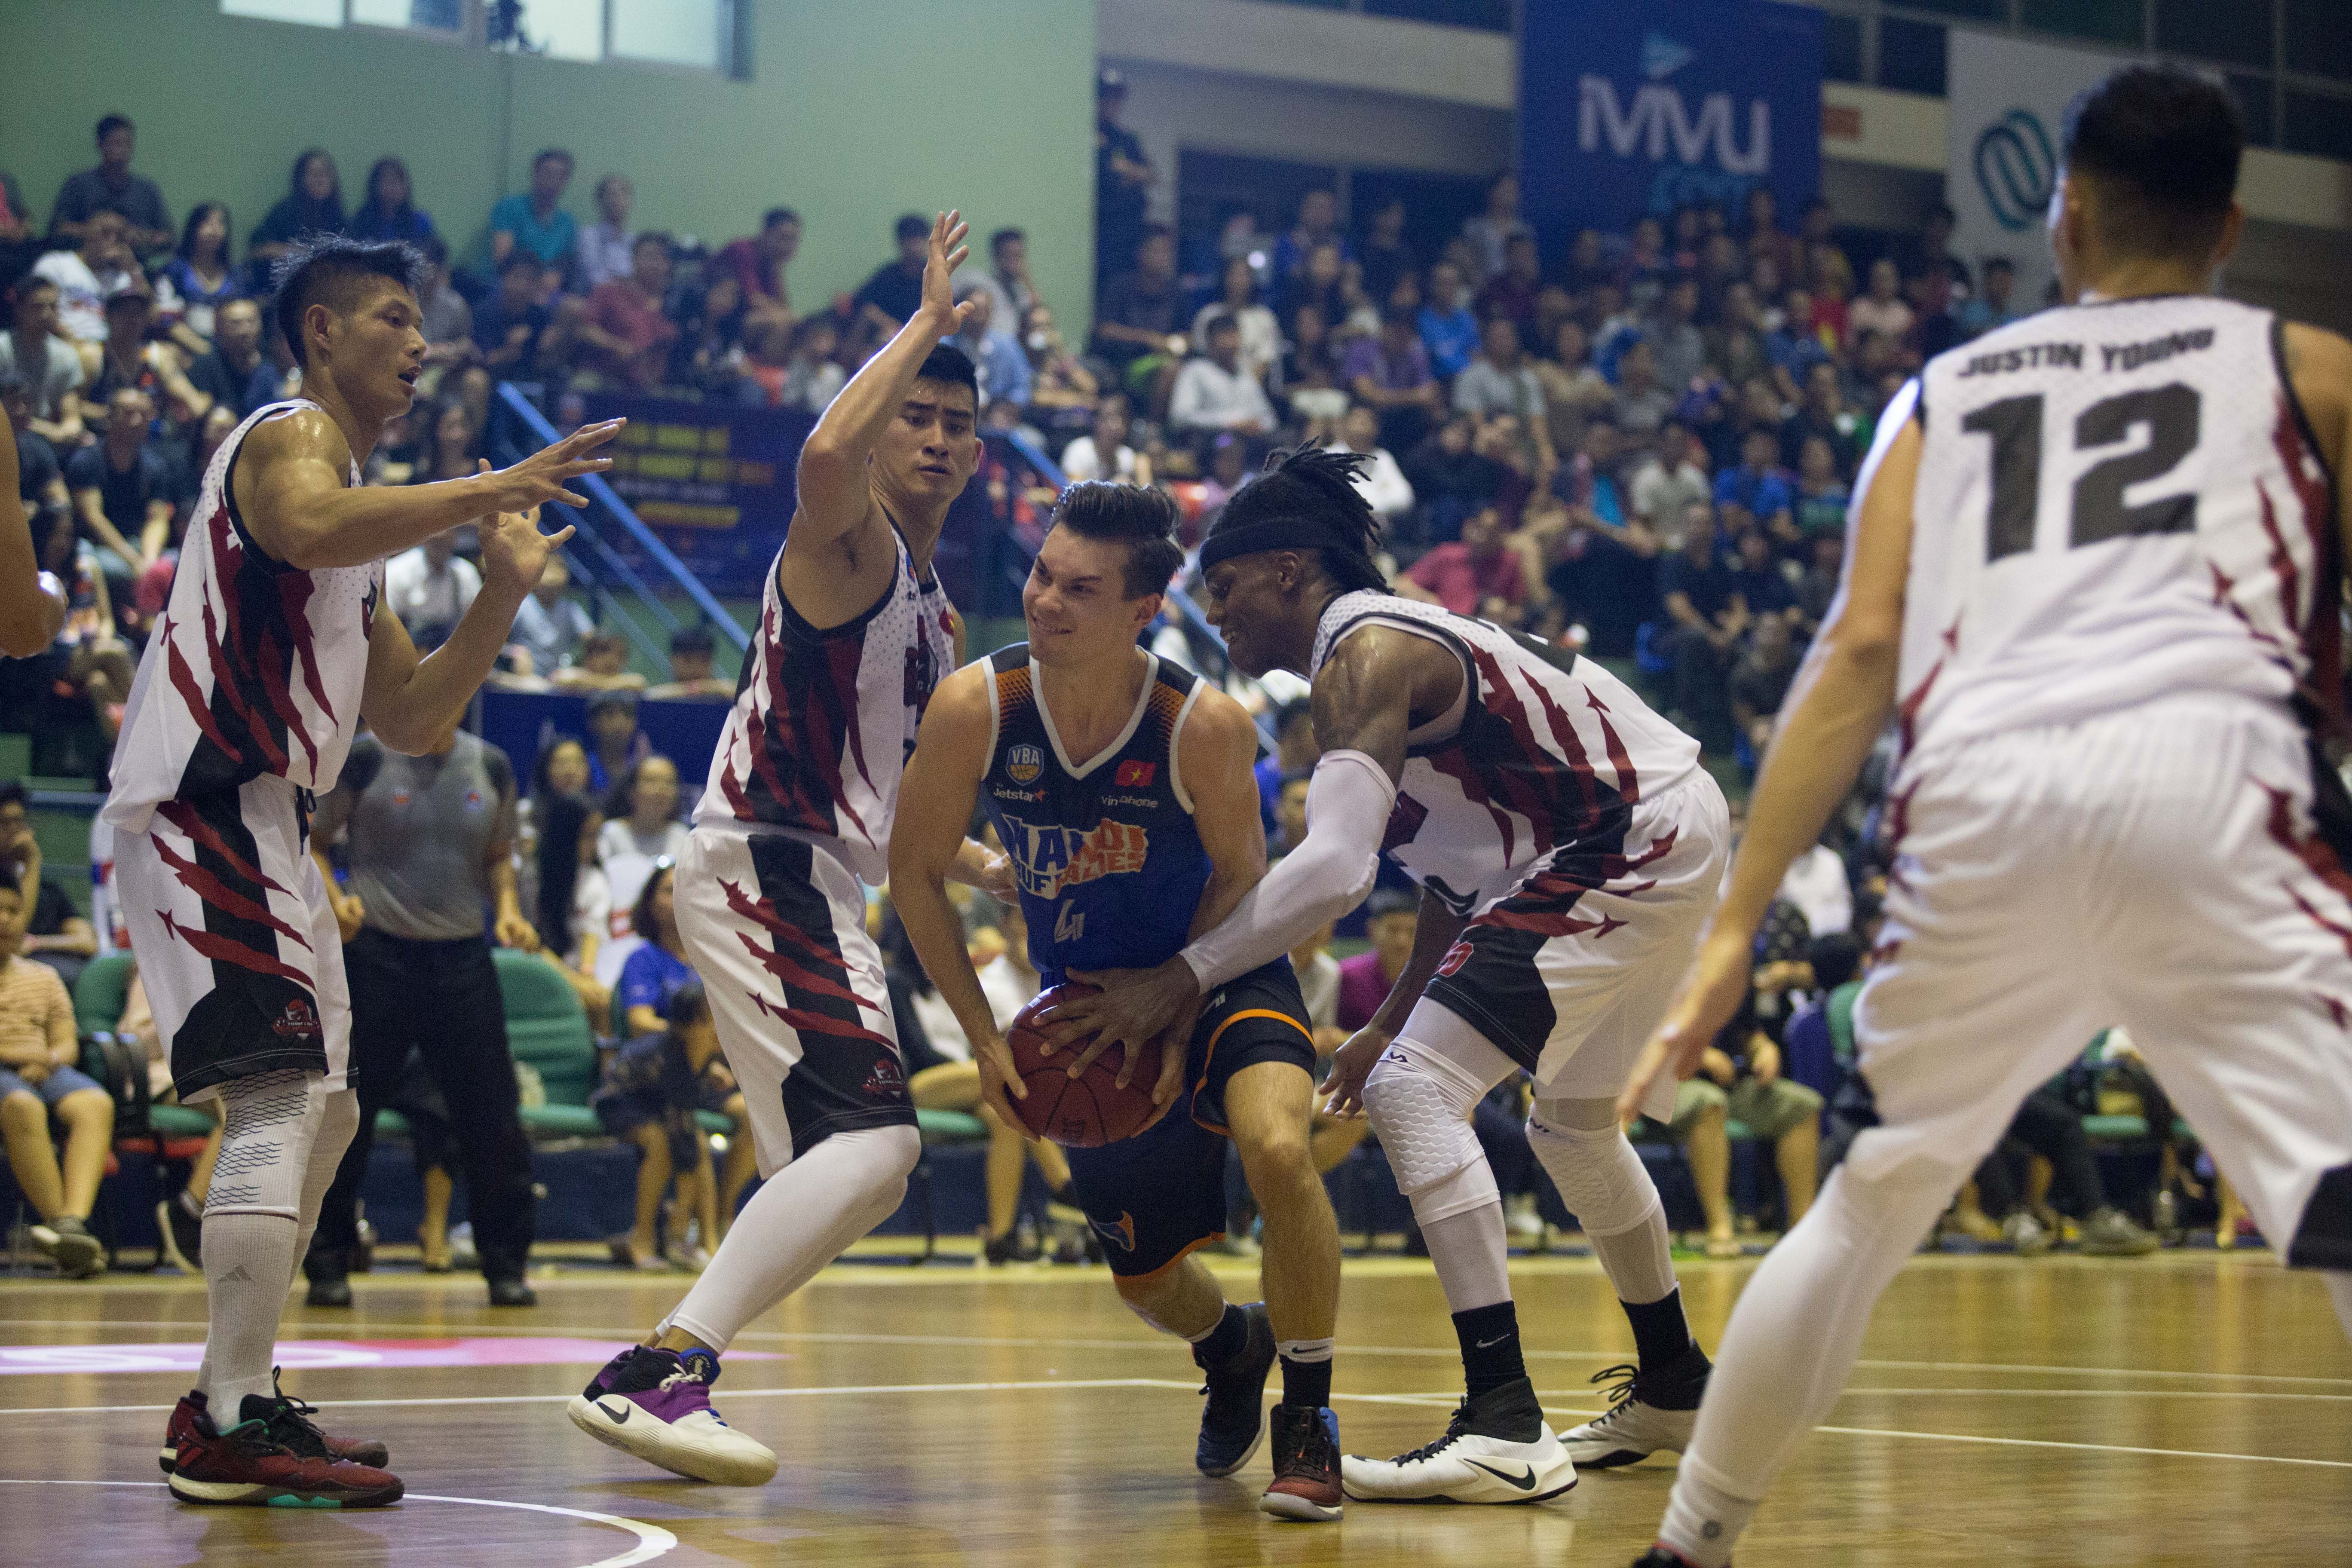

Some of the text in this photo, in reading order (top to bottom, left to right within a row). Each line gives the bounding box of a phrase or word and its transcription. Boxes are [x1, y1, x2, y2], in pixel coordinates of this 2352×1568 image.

[1577, 75, 1771, 174] MMU
[1957, 327, 2217, 378] JUSTIN YOUNG
[1960, 381, 2203, 567] 12
[1012, 747, 1040, 765] VBA
[993, 787, 1035, 802] Jetstar
[1054, 899, 1085, 943] 4
